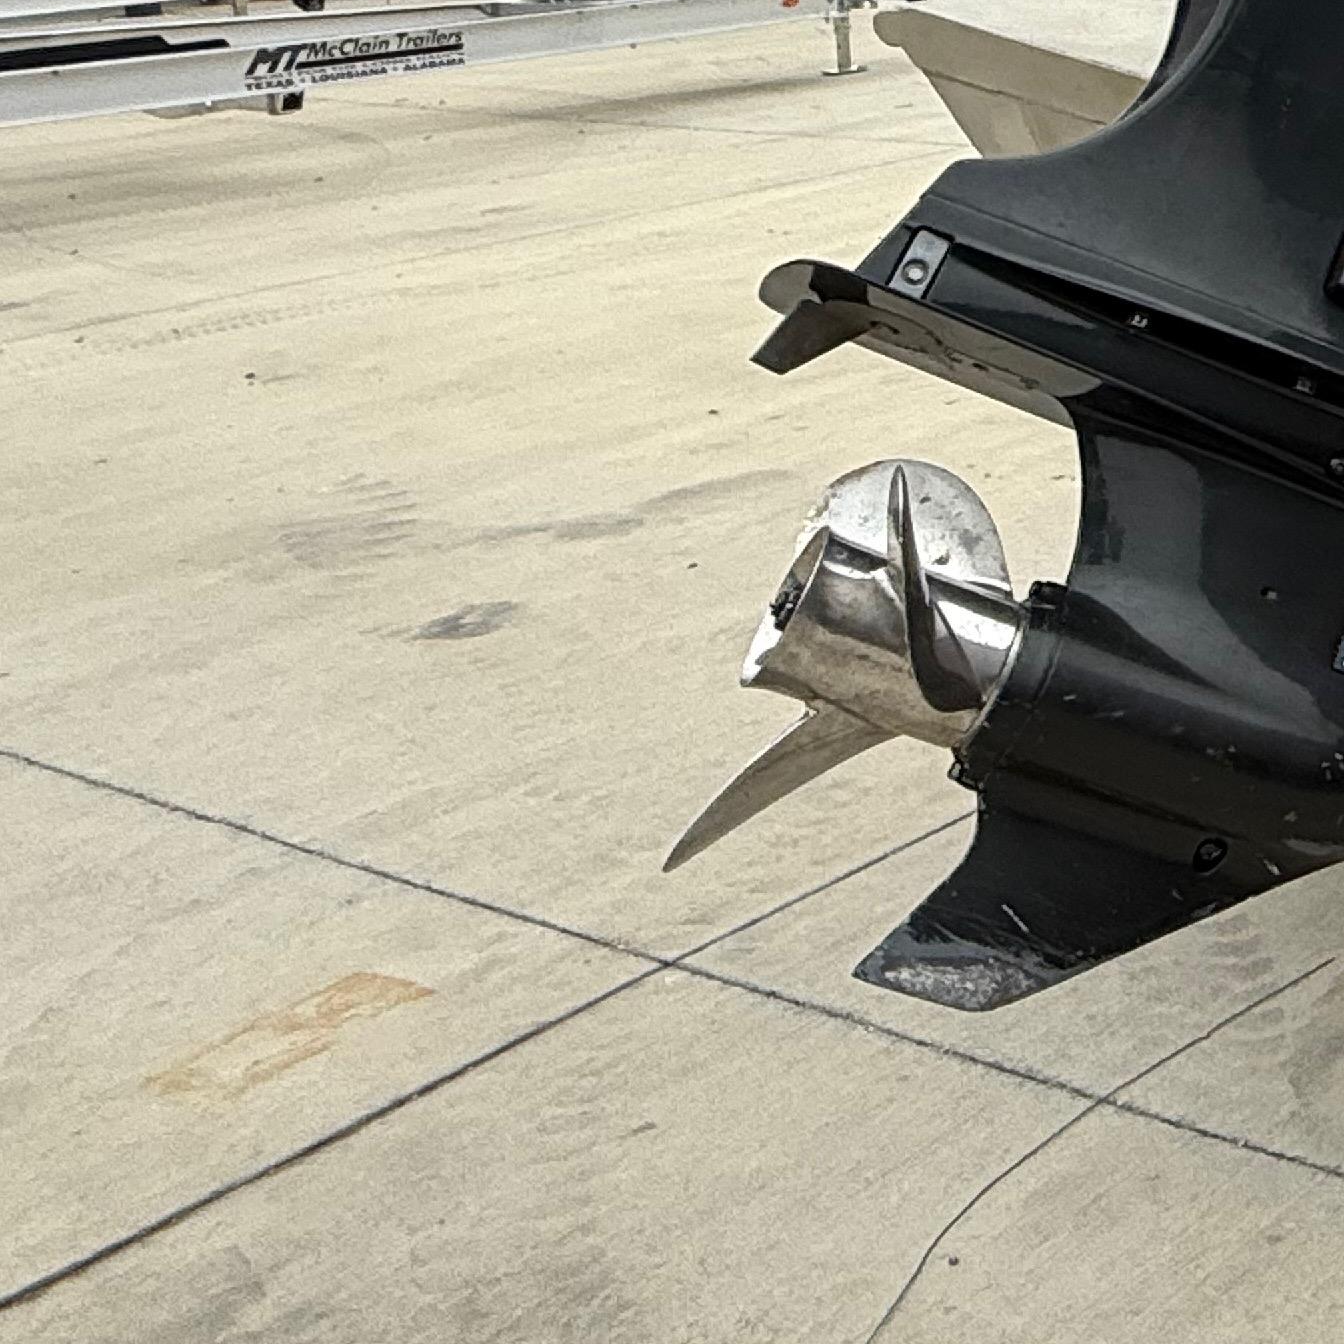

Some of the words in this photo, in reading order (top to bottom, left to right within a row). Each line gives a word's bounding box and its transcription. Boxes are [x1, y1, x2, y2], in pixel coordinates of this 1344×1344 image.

[305, 36, 390, 60] McClain
[396, 29, 463, 50] Trailers
[244, 78, 295, 91] TEXAS
[310, 66, 388, 83] LOUISIANA
[402, 57, 465, 72] ALABAMA
